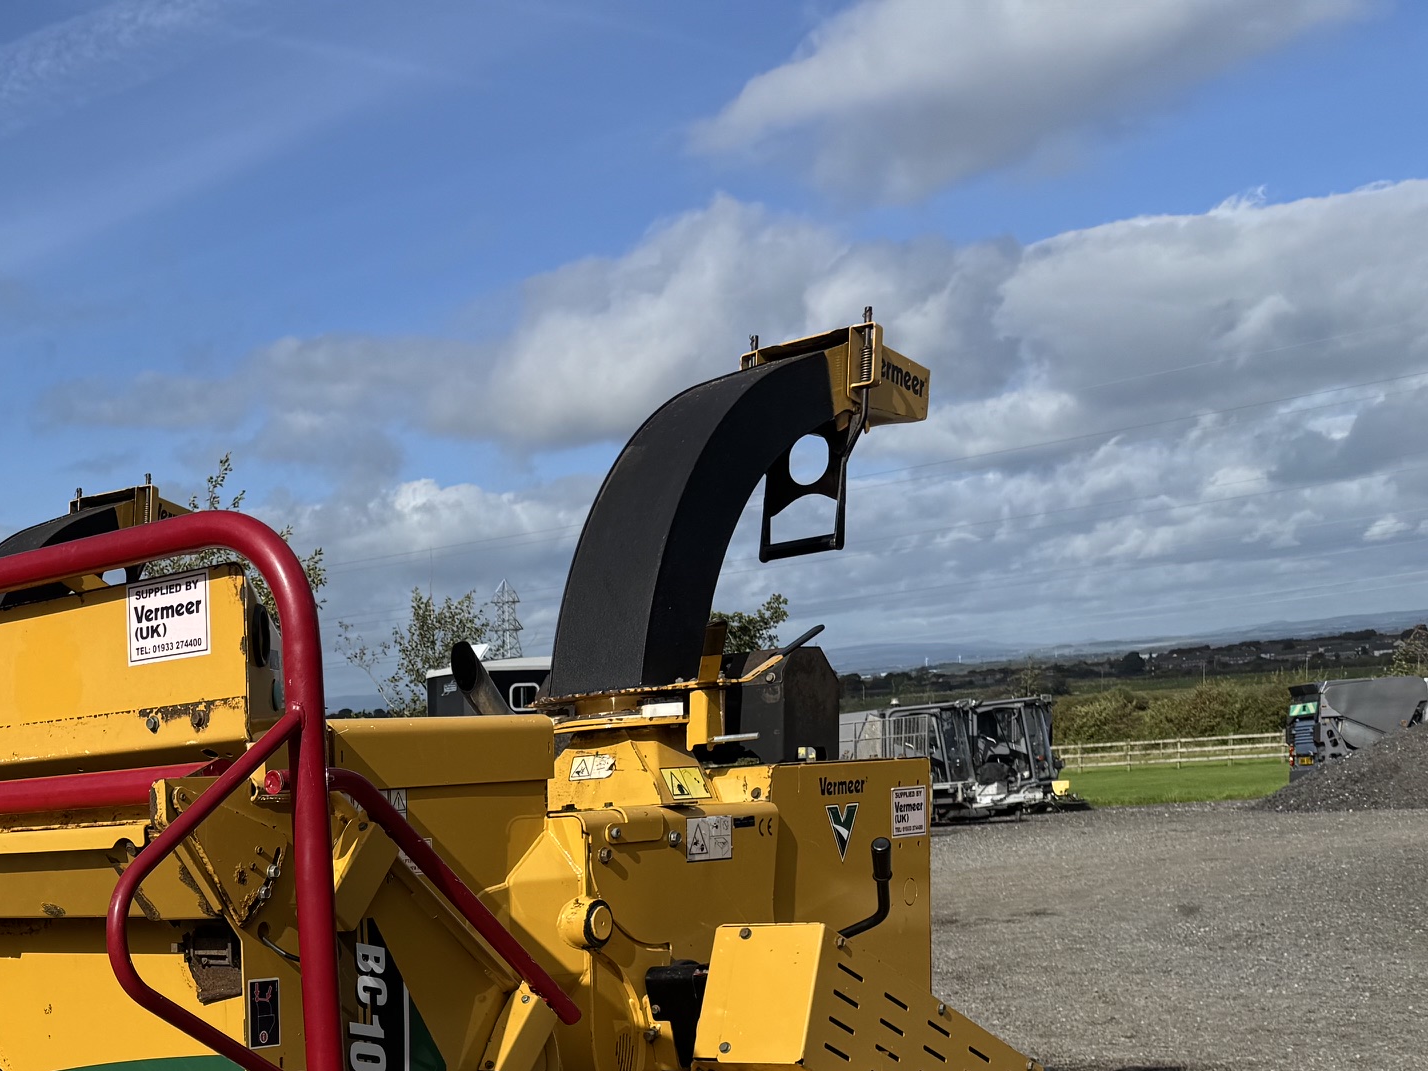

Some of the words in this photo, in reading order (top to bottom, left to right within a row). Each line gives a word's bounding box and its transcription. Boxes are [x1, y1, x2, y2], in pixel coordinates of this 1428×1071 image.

[135, 583, 182, 600] SUPPLIED
[185, 579, 199, 592] BY
[134, 600, 202, 624] Vermeer
[135, 622, 167, 642] (UK)
[136, 646, 151, 656] TEL:
[152, 642, 174, 654] 01933
[175, 637, 202, 649] 274400
[818, 776, 865, 796] Vermeer
[894, 801, 924, 813] Vermeer
[895, 813, 910, 824] (UK)
